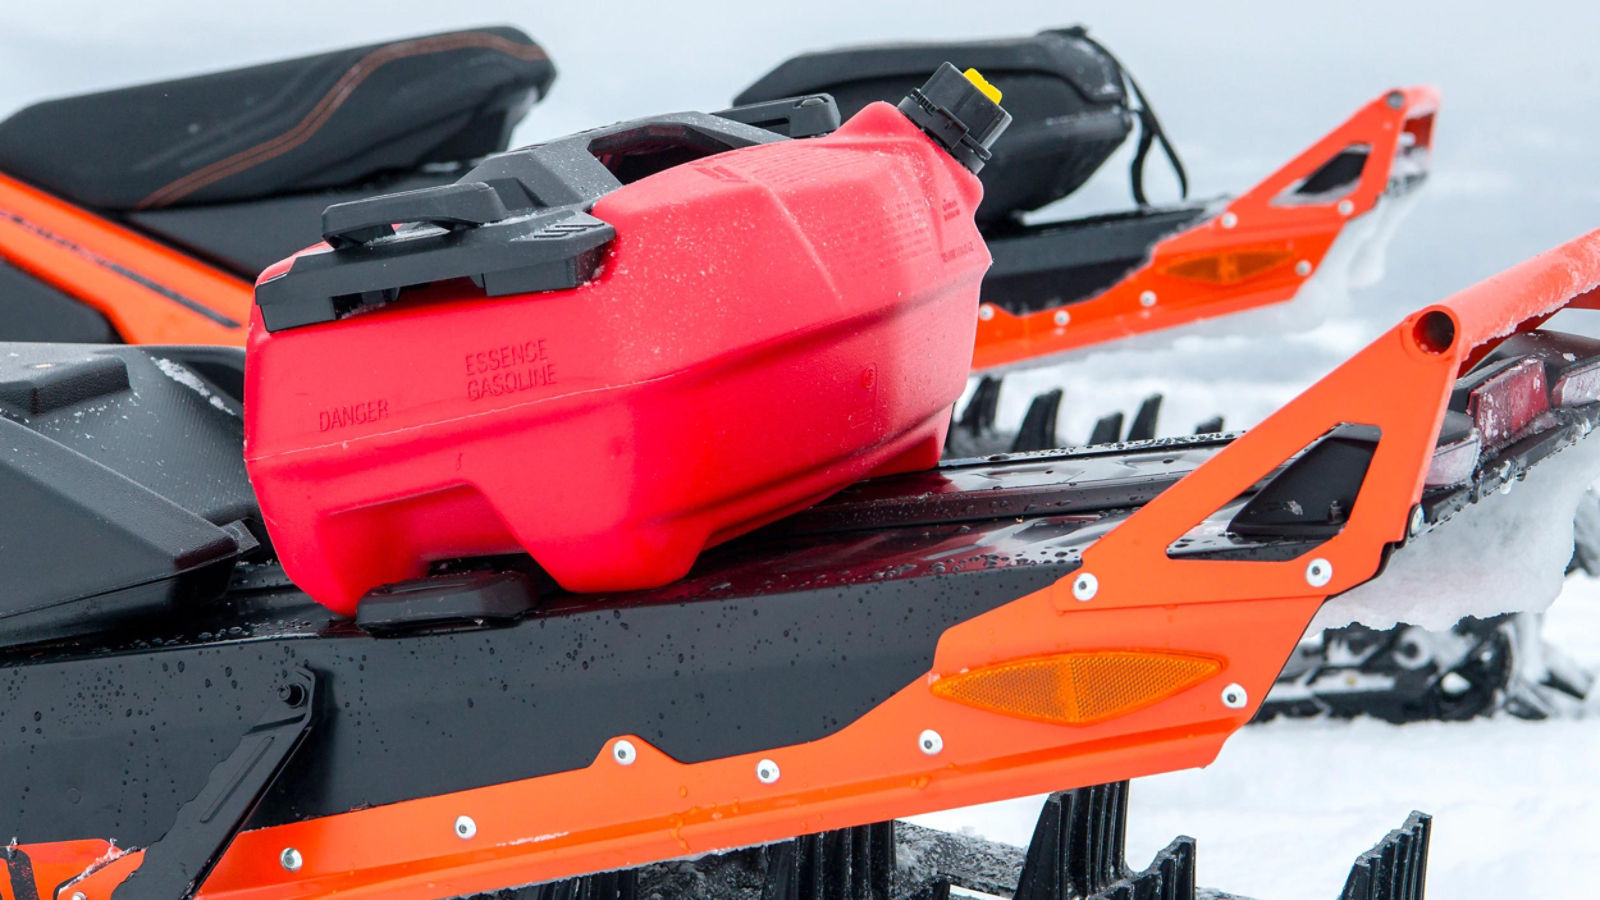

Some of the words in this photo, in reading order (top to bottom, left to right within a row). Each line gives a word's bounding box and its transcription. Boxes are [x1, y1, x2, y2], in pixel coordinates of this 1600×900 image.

[465, 339, 548, 376] ESSENCE
[467, 364, 557, 401] GASOLINE
[319, 400, 389, 432] DANGER
